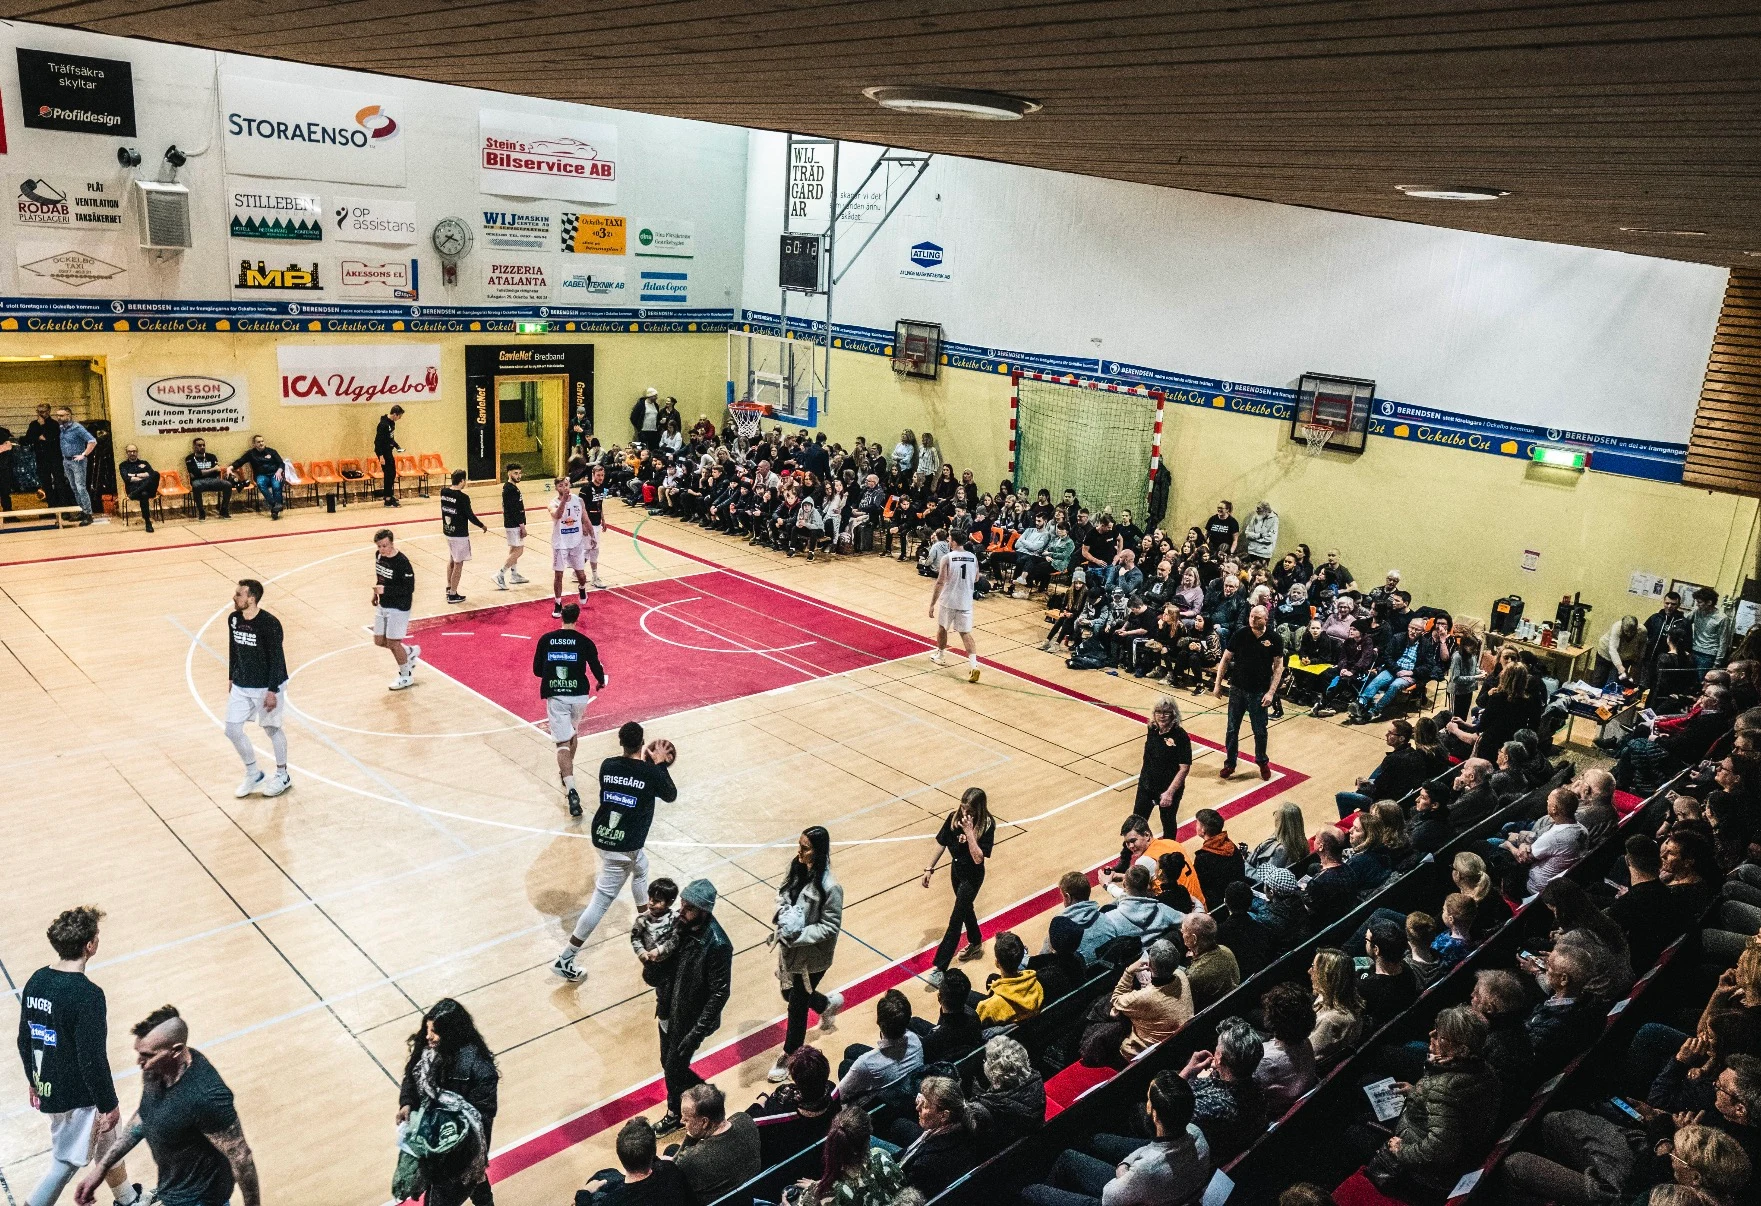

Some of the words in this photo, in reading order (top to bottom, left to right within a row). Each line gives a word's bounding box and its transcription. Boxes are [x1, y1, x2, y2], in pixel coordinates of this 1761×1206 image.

[48, 62, 105, 78] Träffsäkra
[58, 77, 98, 89] skyltar
[53, 107, 121, 126] Profildesign
[486, 151, 585, 175] Bilservice
[589, 162, 612, 177] AB
[792, 164, 824, 182] TRÄD
[87, 181, 104, 192] PLÅT
[791, 182, 824, 200] GÅRD
[75, 197, 119, 208] VENTILATION
[234, 193, 315, 211] STILLEBEN
[18, 202, 69, 215] RODAB
[352, 207, 370, 218] OP
[790, 200, 807, 217] AR
[19, 212, 70, 223] PLÅTSLAGERI
[75, 212, 122, 224] TAKSÄKERHET
[483, 211, 517, 226] WIJ
[604, 218, 623, 227] TAXI
[353, 218, 416, 233] assistans
[53, 256, 95, 265] OCKELBO
[913, 250, 941, 259] ATLING
[345, 269, 391, 278] ÅKESSONS
[393, 271, 404, 279] EL
[491, 264, 544, 275] PIZZERIA
[246, 269, 312, 287] MP
[488, 276, 547, 287] ATALANTA
[562, 280, 586, 288] KABEL
[589, 281, 614, 289] TEKNIK
[641, 281, 666, 291] Atlas
[665, 281, 688, 293] Copco
[127, 303, 172, 311] BERENDSEN
[27, 318, 79, 331] Ockelbo
[81, 318, 104, 331] Ost
[138, 318, 184, 331] Ockelbo
[186, 318, 207, 331] Ost
[238, 319, 280, 331] Ockelbo
[281, 319, 300, 331] Ost
[328, 319, 367, 331] Ockelbo
[368, 320, 385, 331] Ost
[410, 320, 446, 331] Ockelbo
[447, 320, 464, 331] Ost
[580, 321, 610, 332] Ockelbo
[611, 321, 624, 332] Ost
[643, 322, 671, 332] Ockelbo
[844, 340, 868, 352] Ockelbo
[868, 342, 880, 354] Ost
[499, 350, 532, 361] GavleNet
[534, 352, 565, 360] Bredband
[952, 355, 979, 369] Ockelbo
[980, 360, 993, 372] Ost
[1120, 367, 1154, 378] BERENDSEN
[157, 384, 221, 395] HANSSON
[282, 375, 327, 398] ICA
[327, 374, 426, 402] Ugglebo
[1234, 384, 1272, 395] BERENDSEN
[1188, 391, 1206, 405] Ost
[476, 387, 487, 424] GavleNet
[1231, 397, 1271, 415] Ockelbo
[1272, 404, 1291, 418] Ost
[145, 409, 160, 417] Allt
[188, 407, 239, 416] Transporter,
[1397, 406, 1441, 420] BERENDSEN
[1486, 421, 1509, 430] Ockelbo
[141, 418, 176, 427] Schakt-
[196, 415, 239, 424] Krossning
[158, 425, 230, 434] www.hansson.se
[1417, 426, 1466, 446] Ockelbo
[1468, 434, 1490, 450] Ost
[1565, 431, 1618, 446] BERENDSEN
[960, 563, 967, 580] 1
[550, 638, 576, 646] OLSSON
[549, 679, 578, 688] OCKELBO
[603, 774, 645, 789] FRISEGÅRD
[26, 996, 52, 1014] UNGER
